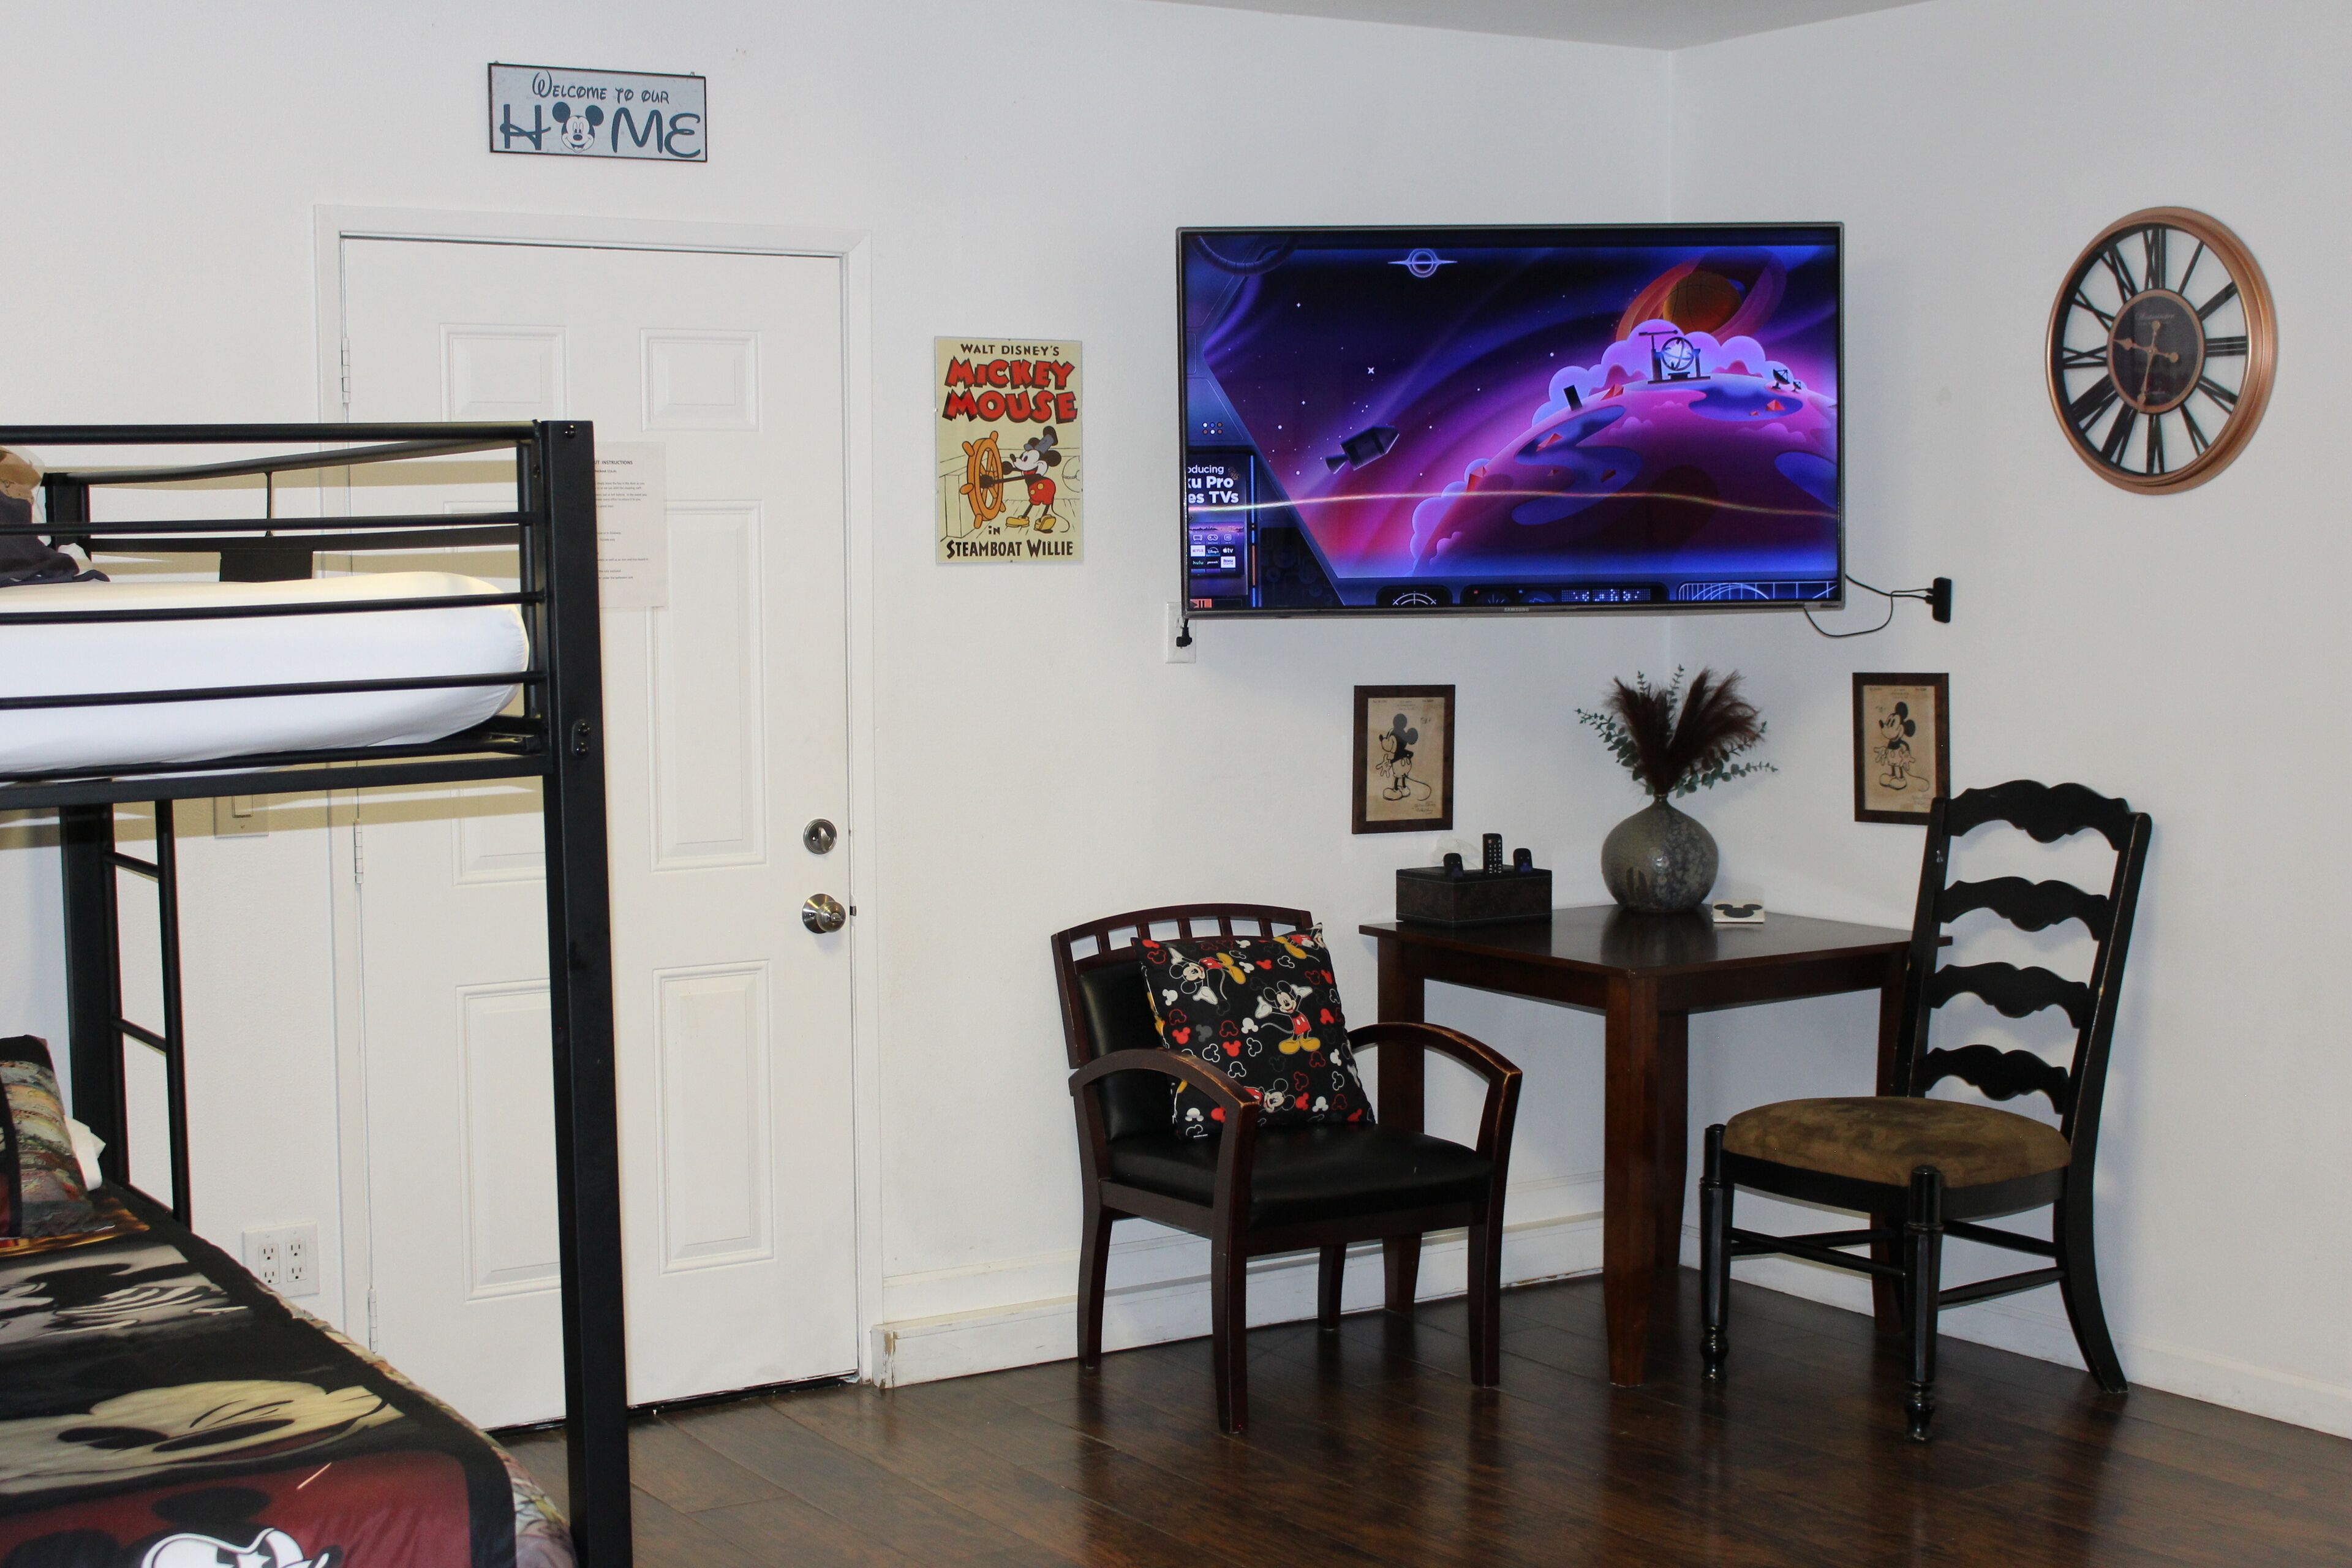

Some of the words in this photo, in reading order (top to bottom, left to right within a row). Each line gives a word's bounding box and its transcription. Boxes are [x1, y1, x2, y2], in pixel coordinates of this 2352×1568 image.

[960, 343, 995, 355] WALT
[1001, 345, 1060, 356] DISNEY'S
[944, 356, 1076, 390] MICKEY
[942, 388, 1078, 424] MOUSE
[1206, 475, 1234, 488] Pro
[1208, 491, 1239, 503] TVs
[946, 539, 1022, 559] STEAMBOAT
[1027, 538, 1073, 557] WILLIE
